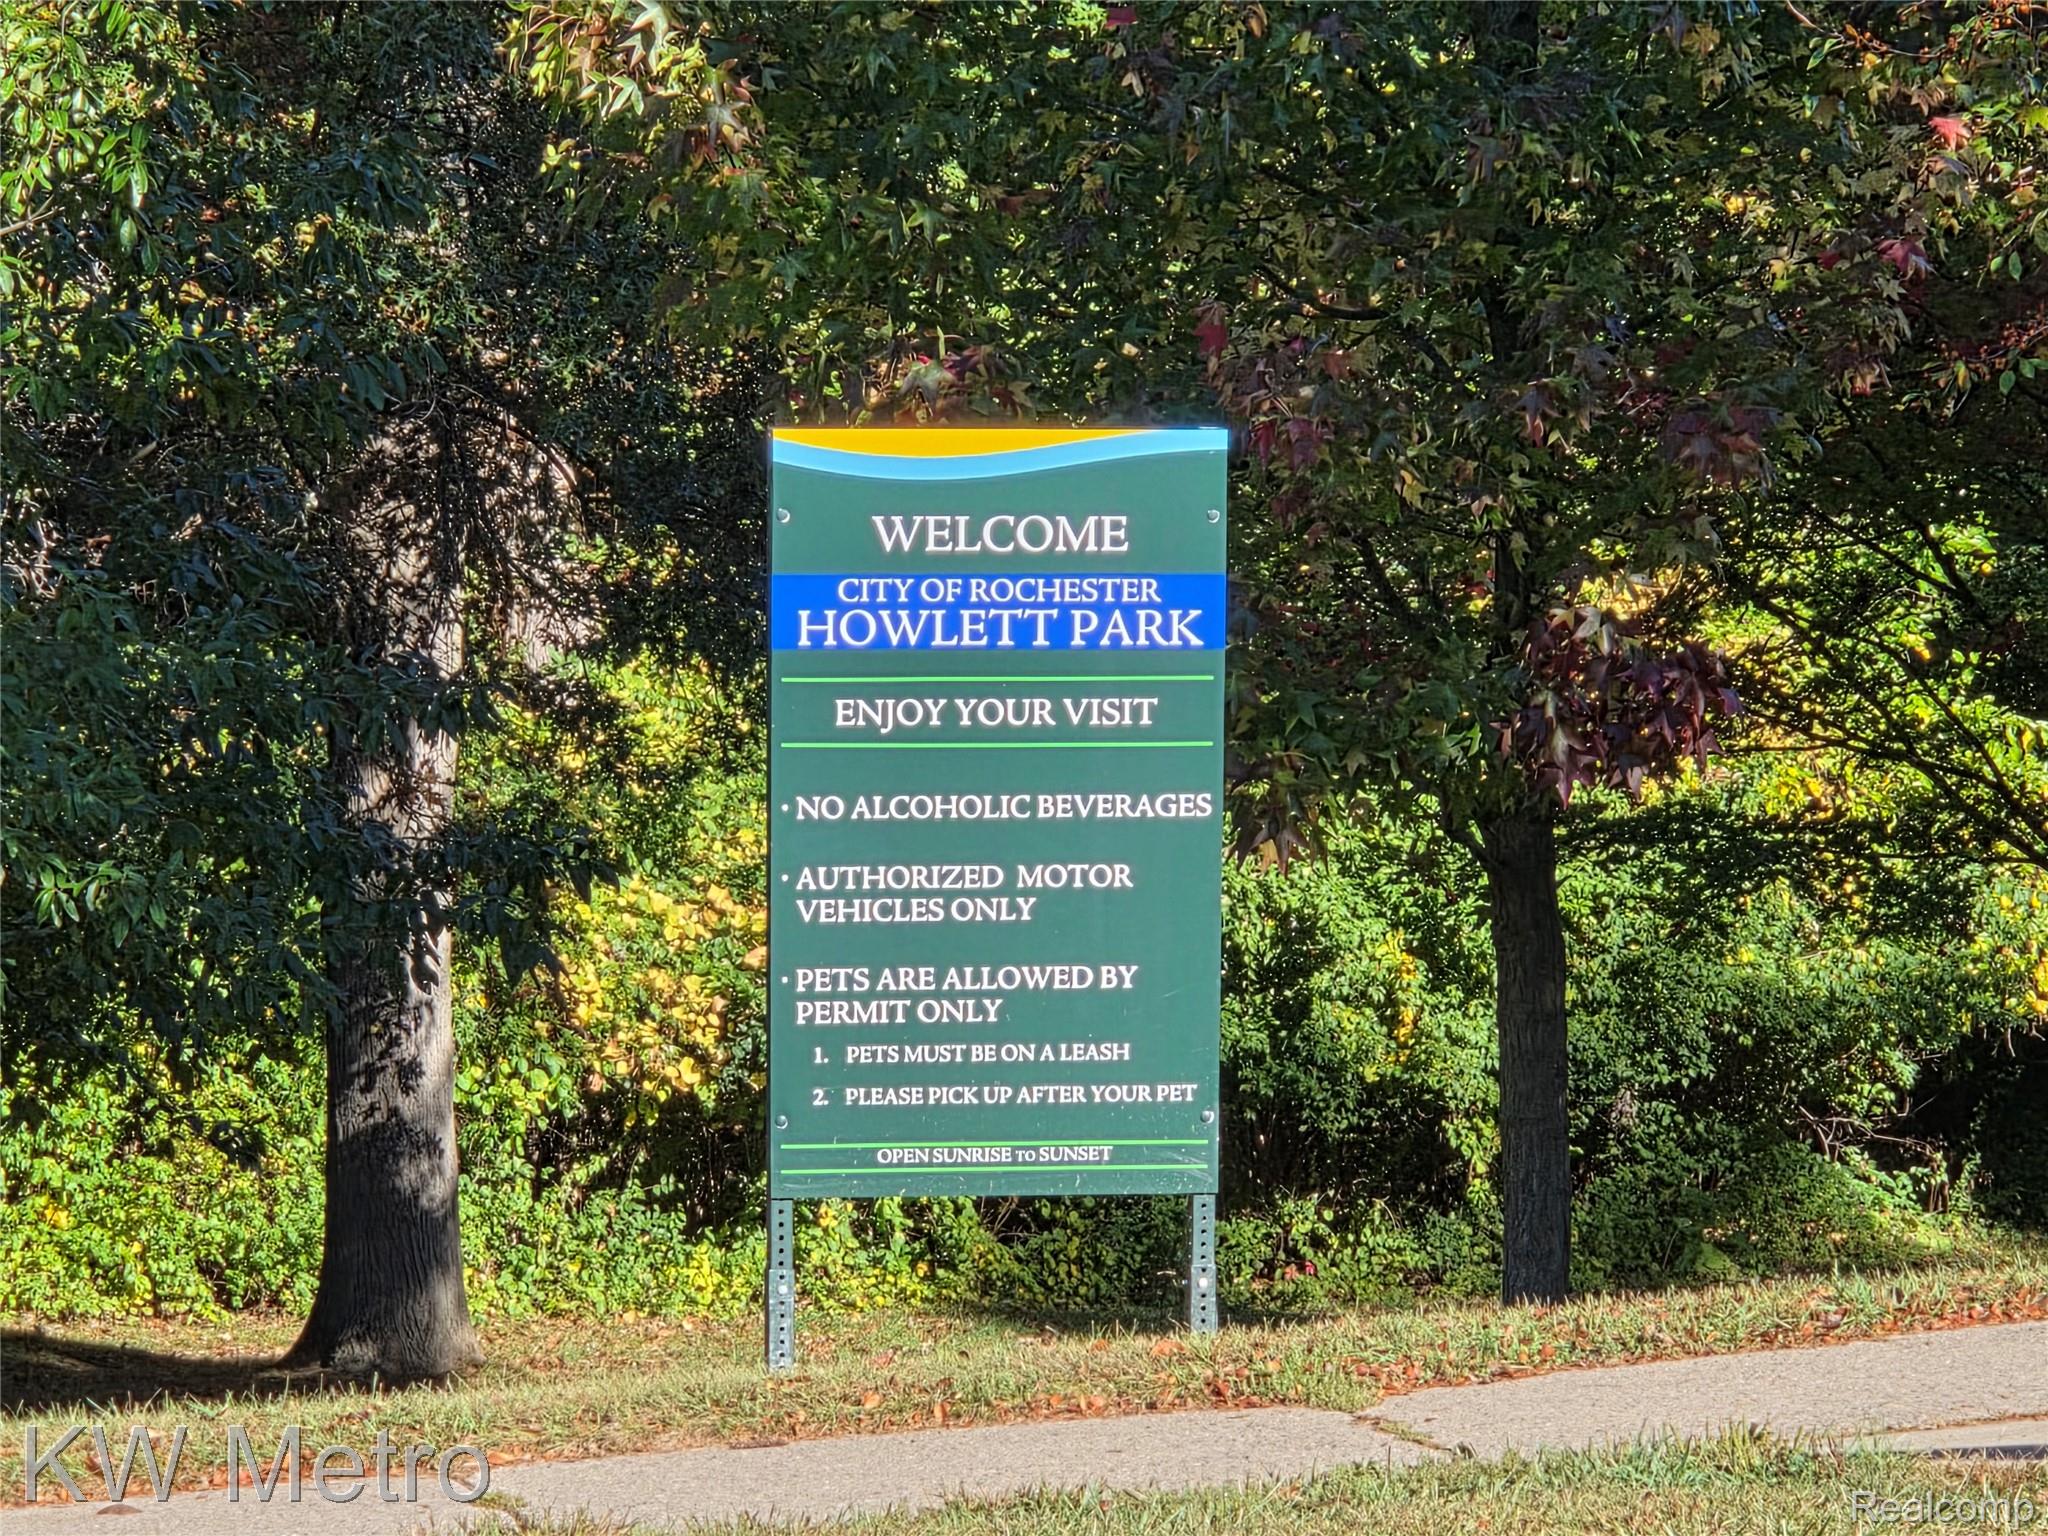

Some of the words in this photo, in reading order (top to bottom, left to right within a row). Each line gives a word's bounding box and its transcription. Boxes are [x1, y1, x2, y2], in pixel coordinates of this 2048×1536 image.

[872, 515, 1129, 553] WELCOME
[837, 578, 914, 603] CITY
[920, 578, 962, 602] OF
[970, 578, 1162, 602] ROCHESTER
[798, 609, 1059, 647] HOWLETT
[1070, 609, 1204, 646] PARK
[835, 699, 953, 734] ENJOY
[954, 699, 1056, 726] YOUR
[1062, 697, 1158, 725] VISIT
[796, 796, 844, 820] NO
[851, 795, 1031, 819] ALCOHOLIC
[1037, 793, 1212, 818] BEVERAGES
[796, 865, 1004, 890] AUTHORIZED
[1017, 864, 1133, 888] MOTOR
[796, 898, 944, 923] VEHICLES
[950, 897, 1036, 921] ONLY
[796, 968, 869, 992] PETS
[876, 967, 936, 991] ARE
[942, 966, 1094, 990] ALLOWED
[1100, 965, 1138, 989] BY
[796, 1000, 911, 1025] PERMIT
[917, 999, 1004, 1023] ONLY
[814, 1047, 829, 1064] 1.
[847, 1045, 899, 1064] PETS
[904, 1044, 966, 1063] MUST
[971, 1044, 996, 1062] BE
[1000, 1044, 1036, 1062] ON
[1040, 1044, 1055, 1061] A
[1060, 1043, 1130, 1061] LEASH
[813, 1089, 829, 1106] 2.
[845, 1087, 923, 1106] PLEASE
[928, 1086, 978, 1104] PICK
[983, 1086, 1012, 1104] UP
[1017, 1085, 1088, 1103] AFTER
[1091, 1084, 1152, 1103] YOUR
[1156, 1084, 1198, 1102] PET
[877, 1148, 929, 1164] OPEN
[932, 1147, 1011, 1163] SUNRISE
[1039, 1146, 1113, 1162] SUNSET
